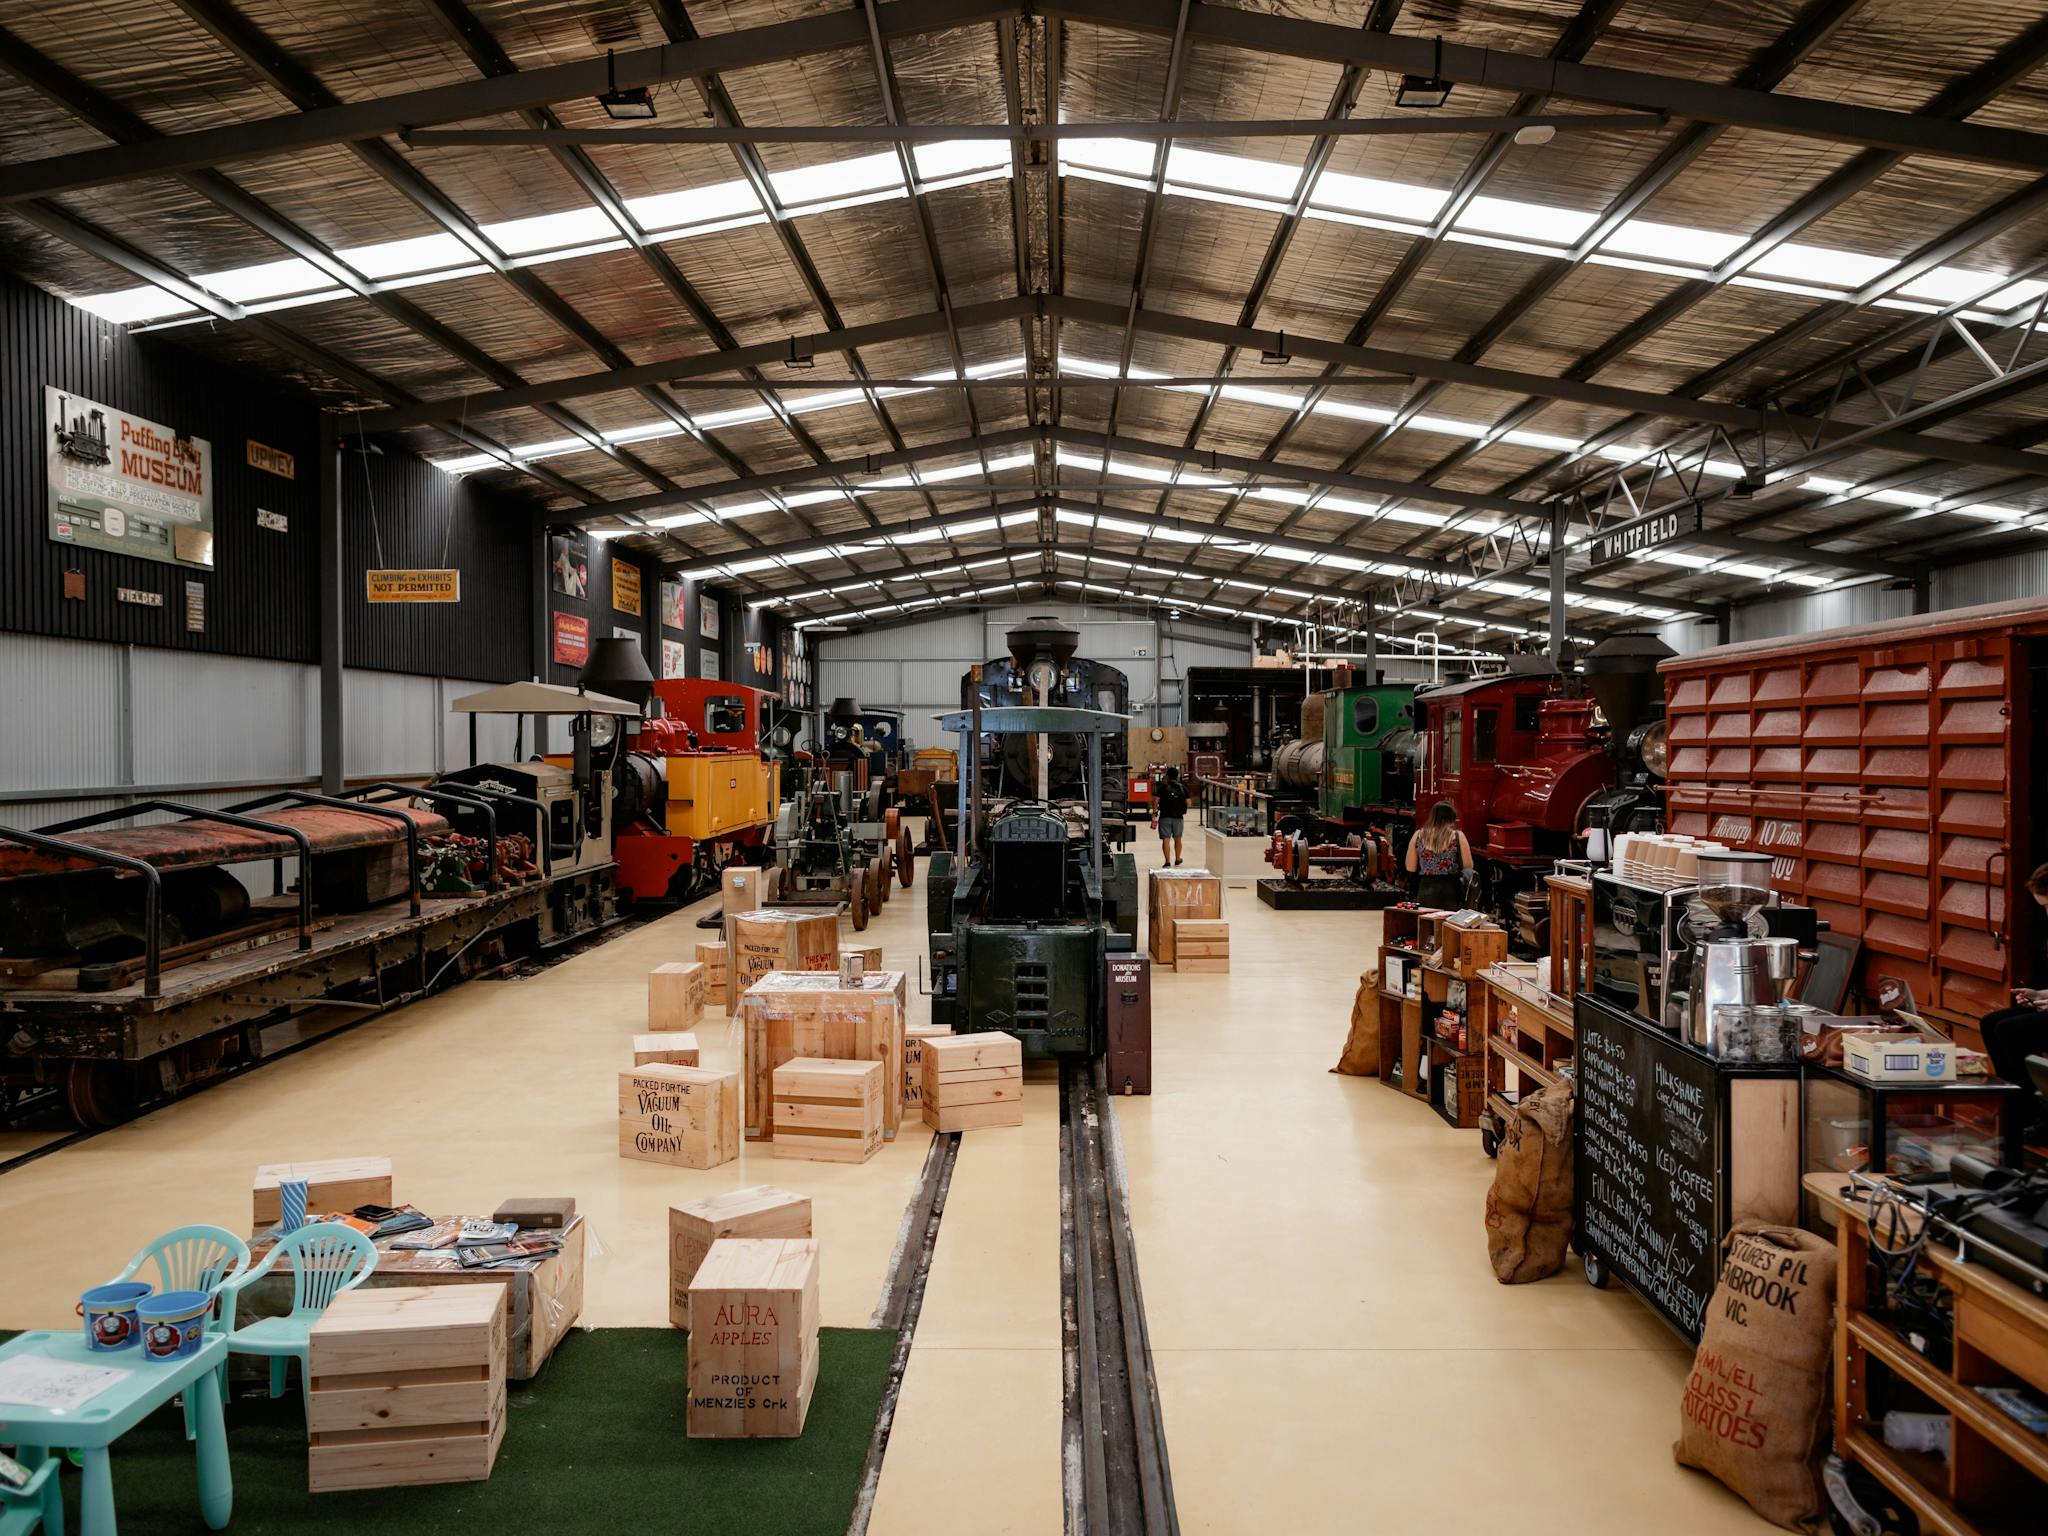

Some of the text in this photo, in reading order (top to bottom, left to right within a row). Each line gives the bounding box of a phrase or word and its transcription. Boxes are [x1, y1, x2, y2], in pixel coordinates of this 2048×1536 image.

[121, 419, 170, 460] Puffing
[121, 449, 203, 497] MUSEUM
[251, 443, 292, 476] UPWEY
[1604, 514, 1678, 558] WHITFIELD
[371, 574, 406, 582] CLIMBING
[417, 573, 452, 582] EXHIBITS
[373, 583, 451, 592] NOT PERMITTED
[120, 591, 162, 605] FIELDER
[1758, 820, 1777, 846] 10
[1776, 822, 1802, 847] Tons
[744, 944, 780, 954] PACKED FOR THE
[805, 952, 832, 965] THIS WAY
[1115, 975, 1137, 983] MUSEUM
[1583, 1028, 1603, 1049] LATTE
[633, 1078, 691, 1095] PACKED FOR THE
[1584, 1066, 1597, 1084] FLAT
[1598, 1075, 1616, 1096] WHITE
[1584, 1083, 1607, 1111] MOCHA
[1584, 1103, 1595, 1121] HOT
[1594, 1112, 1627, 1145] CHOCOLATE
[635, 1127, 684, 1154] COMPANY
[1584, 1123, 1600, 1146] LONG
[1600, 1135, 1621, 1165] BLACK
[1584, 1141, 1602, 1163] SHORT
[1604, 1156, 1628, 1189] BLACK
[1655, 1144, 1713, 1204] ICED COFFEE
[1688, 1219, 1708, 1245] CREAM
[1731, 1238, 1777, 1271] STORES
[1778, 1256, 1808, 1287] P/L
[713, 1303, 779, 1327] AURA
[1682, 1309, 1697, 1333] TEA
[1725, 1295, 1748, 1328] VIC.
[710, 1332, 772, 1345] APPLES
[711, 1375, 781, 1386] PRODUCT
[735, 1386, 753, 1397] OF
[1691, 1371, 1742, 1413] CLASS
[694, 1398, 788, 1410] MENZIES Crk
[1683, 1385, 1768, 1450] POTATOES
